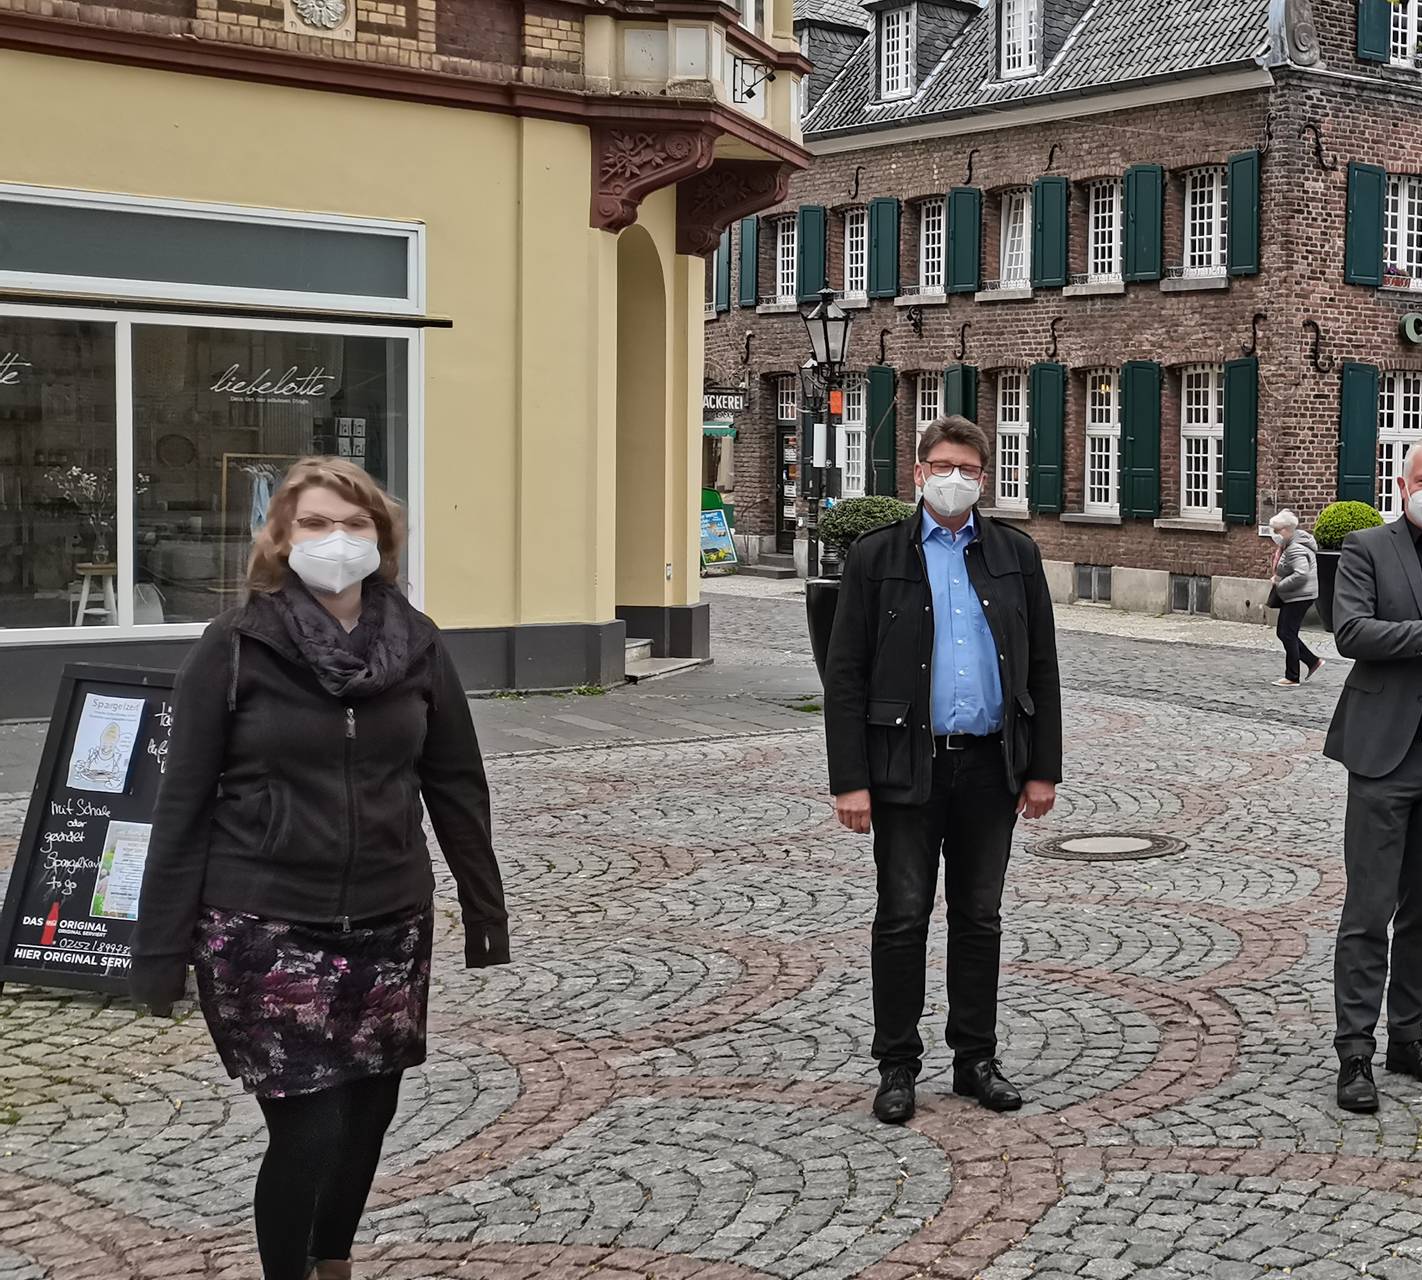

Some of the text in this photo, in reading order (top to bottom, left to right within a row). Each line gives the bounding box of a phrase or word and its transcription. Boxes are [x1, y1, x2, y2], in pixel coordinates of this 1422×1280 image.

[210, 363, 335, 395] liebelotte
[703, 394, 743, 410] ÄCKEREI
[22, 916, 44, 926] DAS
[60, 919, 108, 932] ORIGINAL
[14, 948, 41, 960] HIER
[43, 951, 98, 966] ORIGINAL
